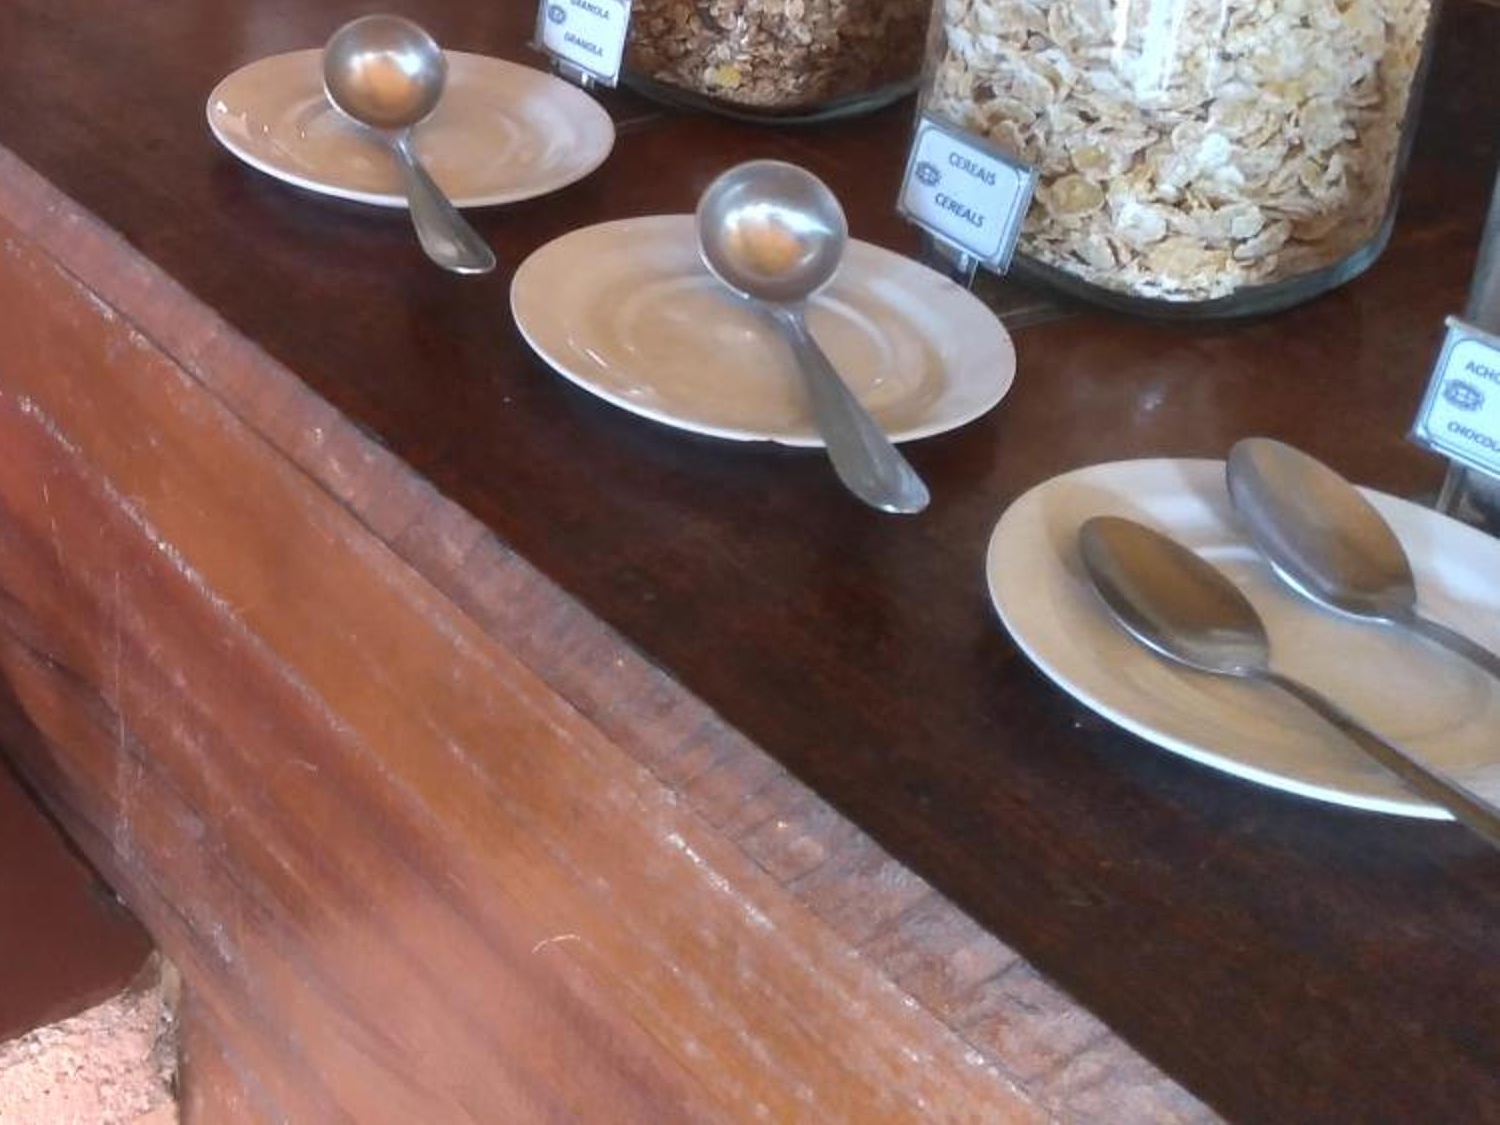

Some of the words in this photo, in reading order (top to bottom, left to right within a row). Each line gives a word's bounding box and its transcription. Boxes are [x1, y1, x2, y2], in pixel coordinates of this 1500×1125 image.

[563, 31, 603, 57] GRANOLA
[948, 152, 996, 187] CEREAIS
[934, 192, 985, 228] CEREALS
